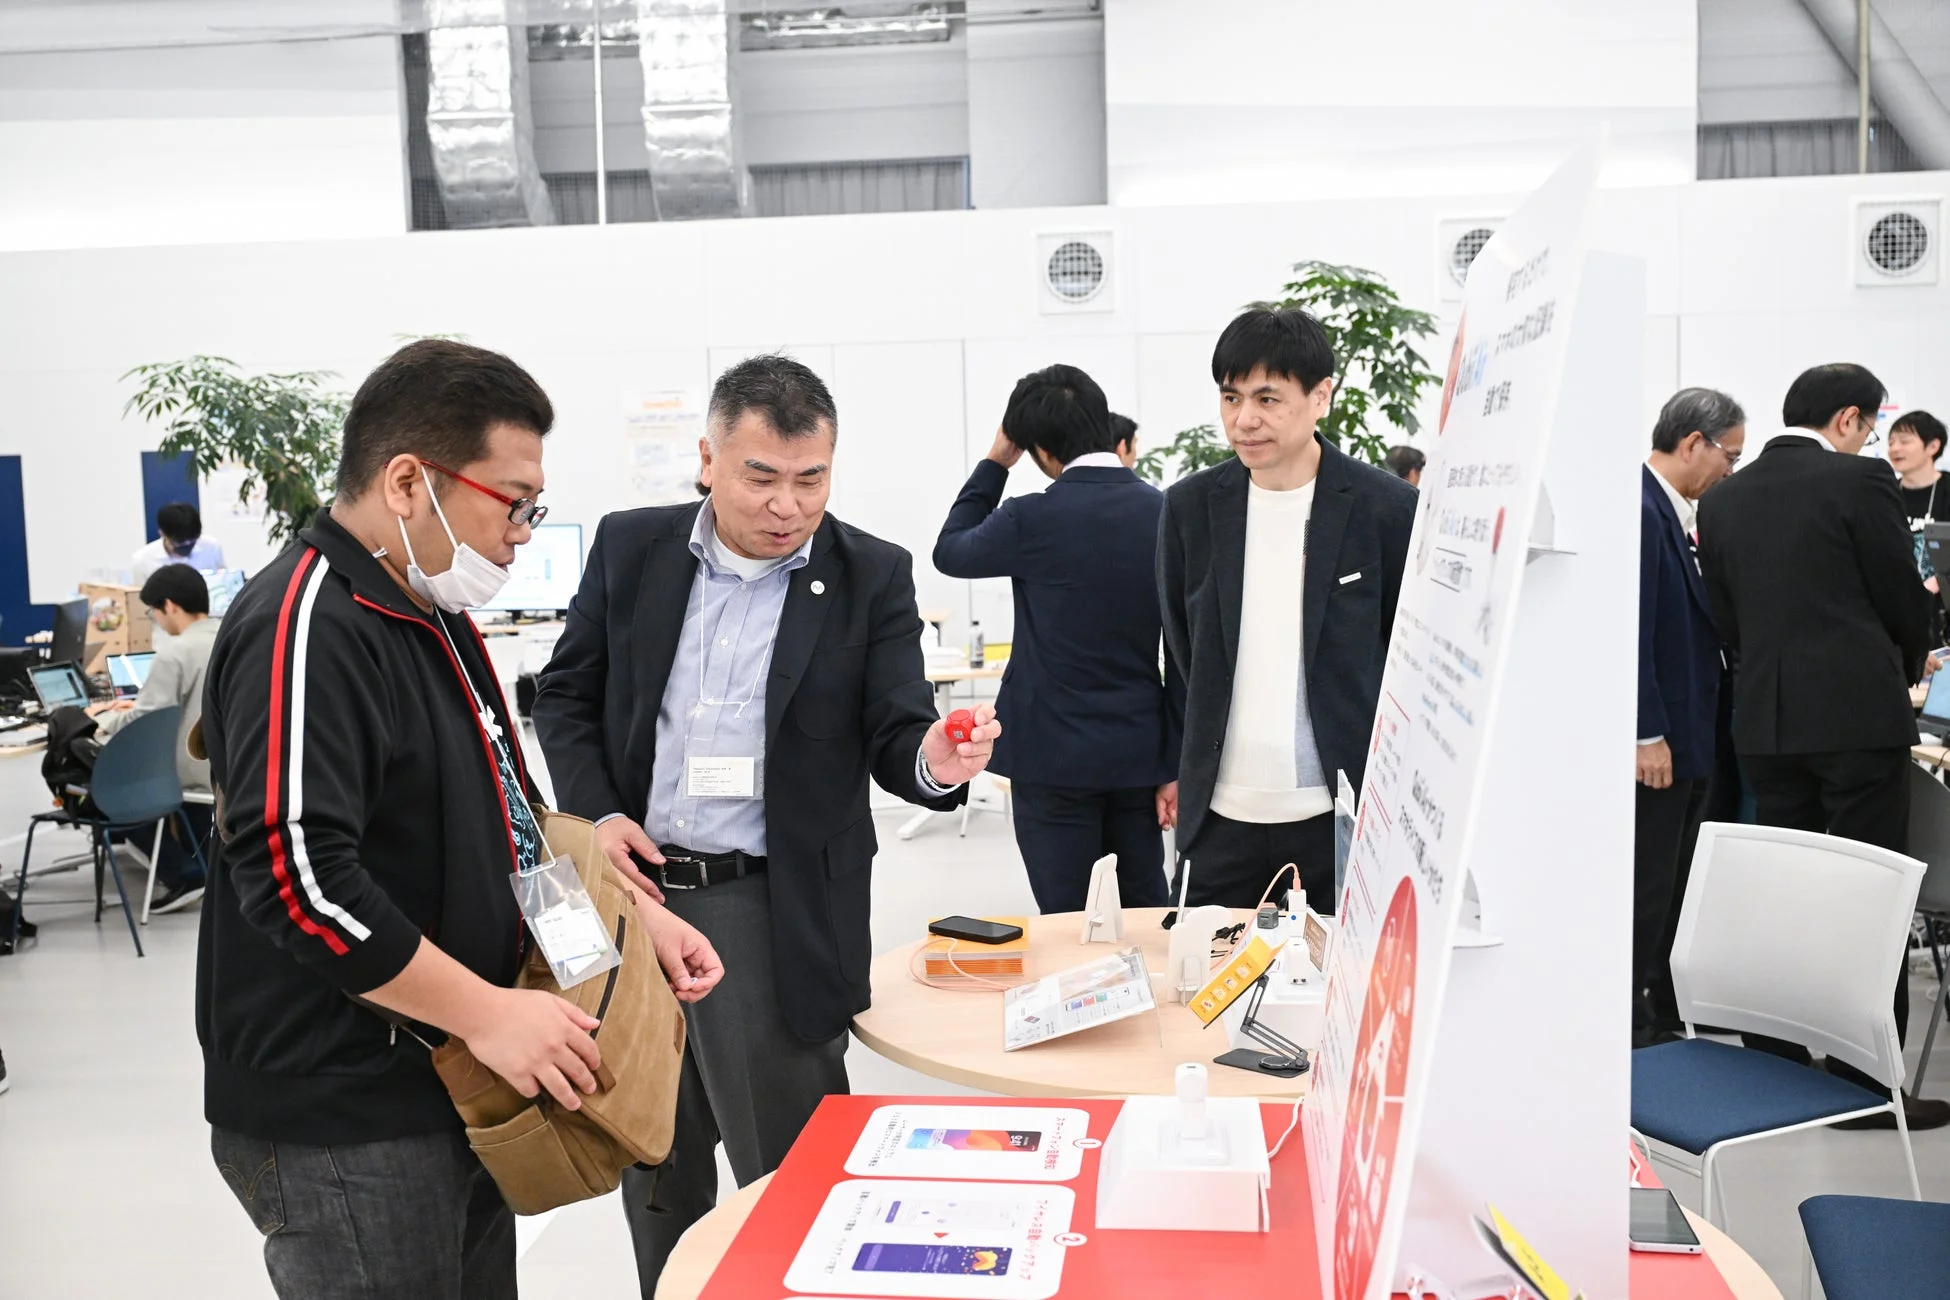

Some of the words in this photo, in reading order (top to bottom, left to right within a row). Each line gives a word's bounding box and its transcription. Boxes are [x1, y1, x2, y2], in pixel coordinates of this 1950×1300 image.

[1019, 1199, 1049, 1280] ワイヤレス自動バックアップ
[1062, 1236, 1081, 1244] 2
